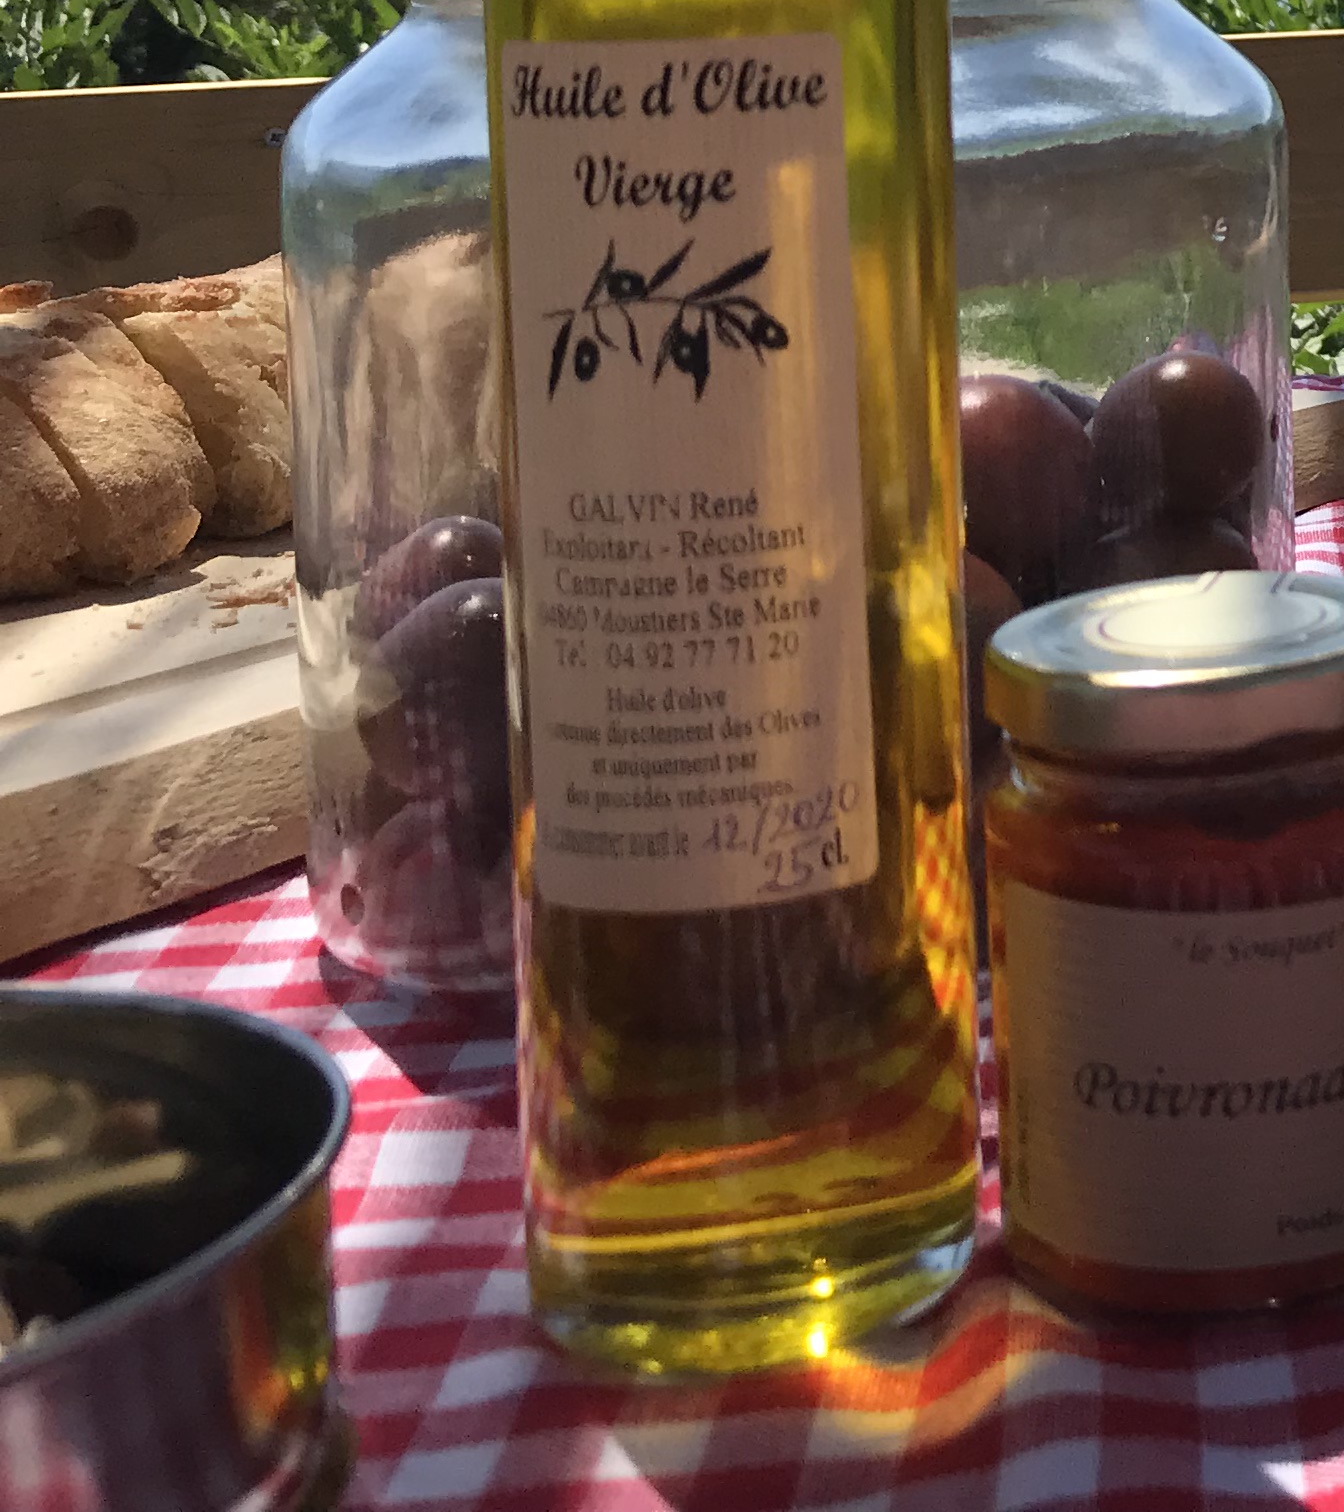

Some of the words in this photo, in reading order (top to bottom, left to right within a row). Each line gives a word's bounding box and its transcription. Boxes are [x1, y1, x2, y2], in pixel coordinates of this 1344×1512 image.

[512, 63, 626, 119] Huile
[640, 57, 828, 118] d'Olive
[574, 154, 736, 224] Vierge
[690, 487, 759, 520] René
[677, 522, 805, 559] Récoltant
[719, 562, 787, 594] Serre
[708, 601, 745, 630] Ste
[605, 641, 635, 669] 04
[683, 638, 716, 667] 77
[725, 635, 756, 665] 71
[768, 630, 799, 660] 20
